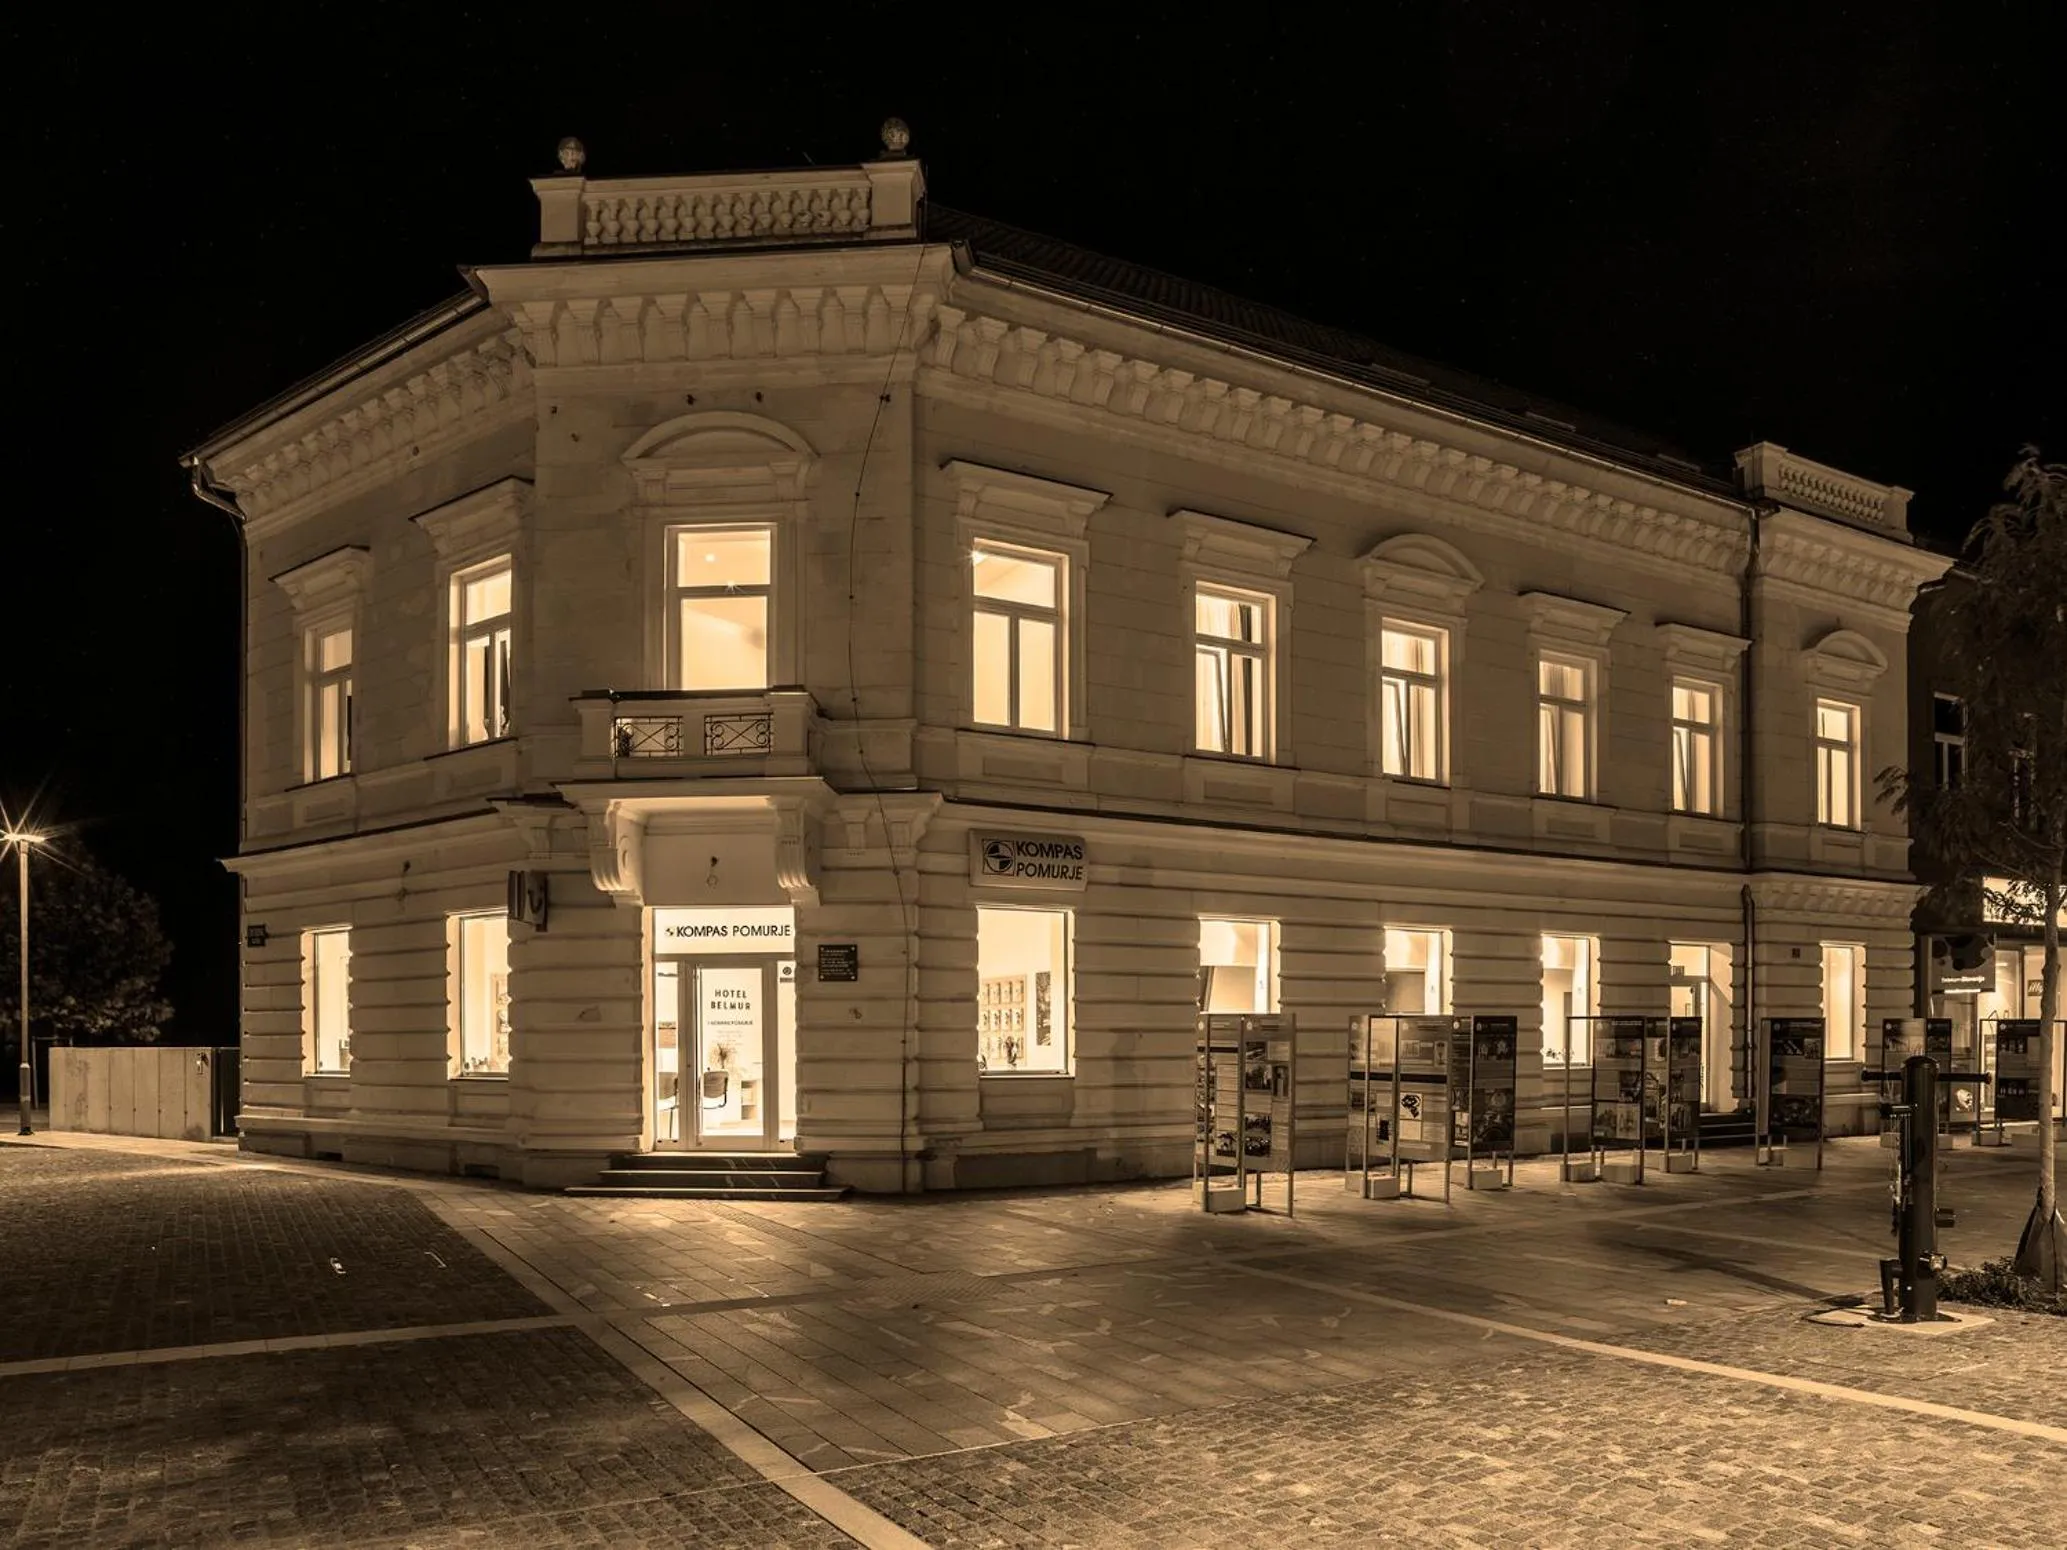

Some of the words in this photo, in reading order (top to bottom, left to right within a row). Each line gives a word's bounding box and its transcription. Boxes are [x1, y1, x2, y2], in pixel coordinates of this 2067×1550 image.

[1016, 841, 1083, 860] KOMPAS
[1016, 862, 1083, 880] POMURJE
[677, 925, 728, 937] KOMPAS
[732, 925, 791, 937] POMURJE
[714, 989, 747, 998] HOTEL
[710, 1001, 751, 1010] BELMUR
